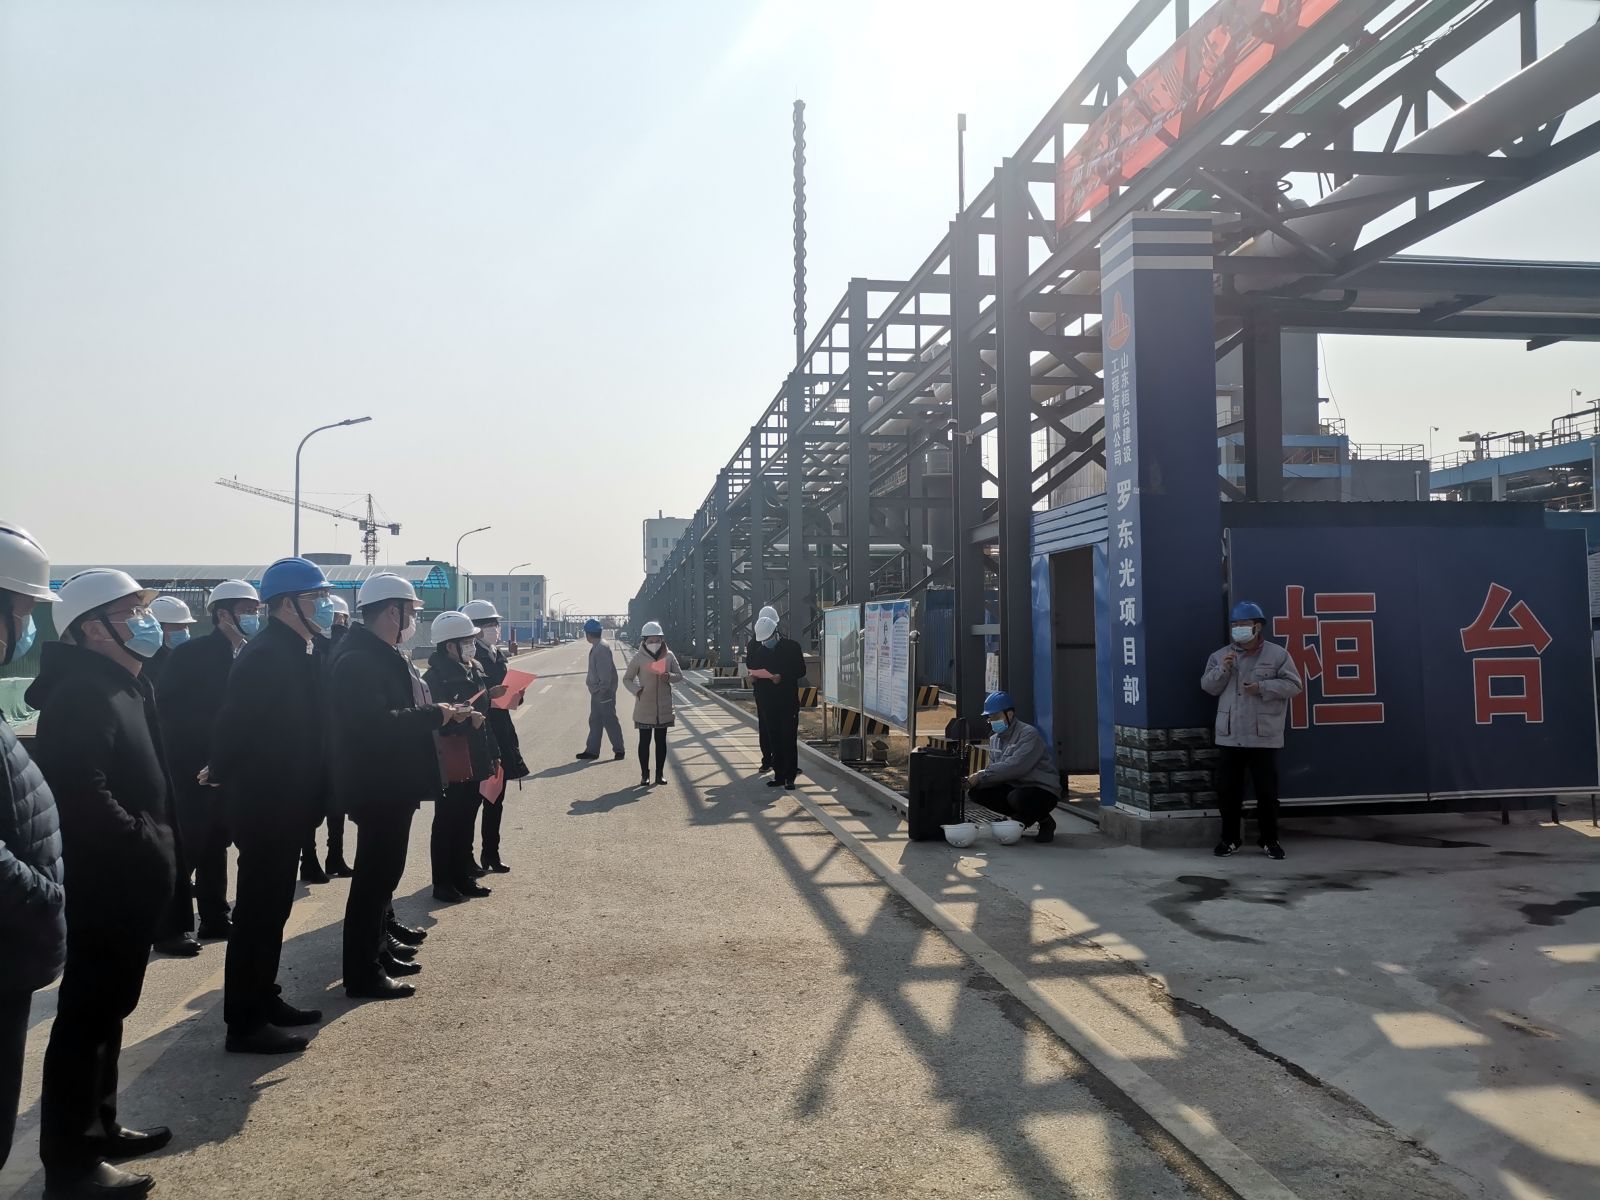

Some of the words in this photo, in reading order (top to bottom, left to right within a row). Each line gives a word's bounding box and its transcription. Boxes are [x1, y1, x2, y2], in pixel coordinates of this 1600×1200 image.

[1111, 358, 1122, 466] 工程有限公司
[1121, 352, 1132, 463] 山东桓台建设
[1117, 479, 1140, 706] 罗东光项目部
[1273, 583, 1553, 728] 桓台
